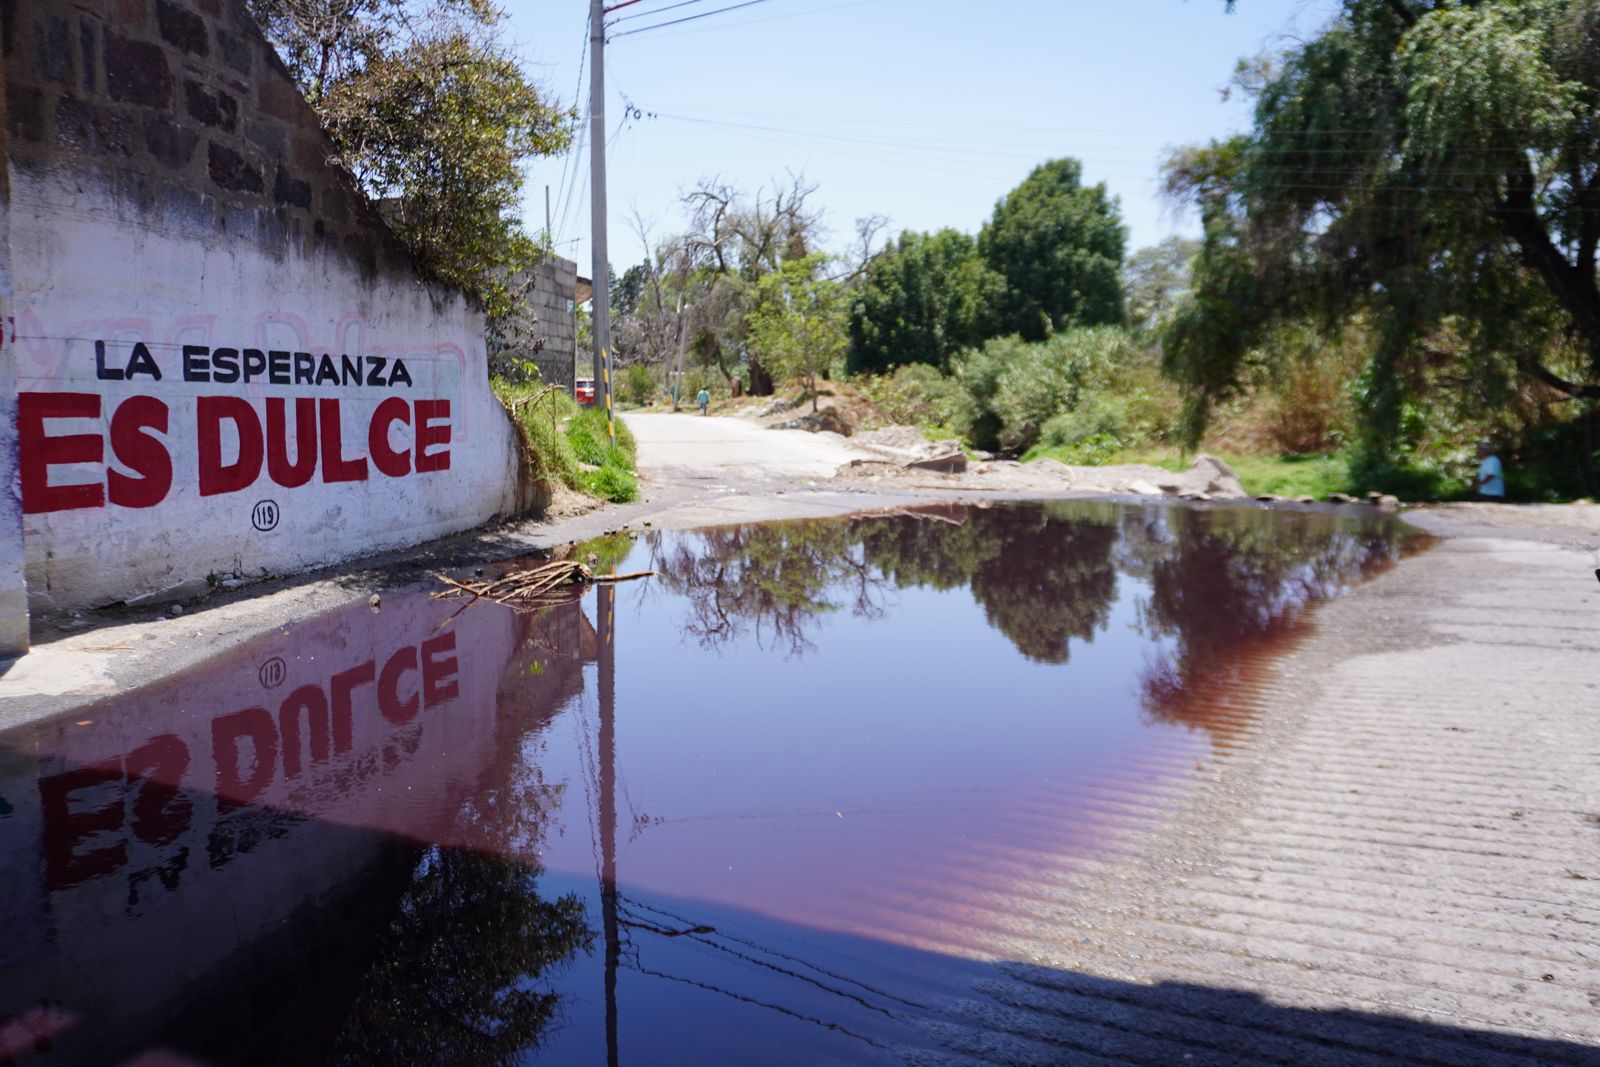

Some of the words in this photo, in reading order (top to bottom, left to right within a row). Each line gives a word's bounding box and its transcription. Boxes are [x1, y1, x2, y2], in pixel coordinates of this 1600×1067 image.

[95, 340, 162, 380] LA
[182, 345, 413, 387] ESPERANZA
[17, 391, 174, 514] ES
[197, 395, 452, 497] DULCE
[256, 504, 274, 526] 119
